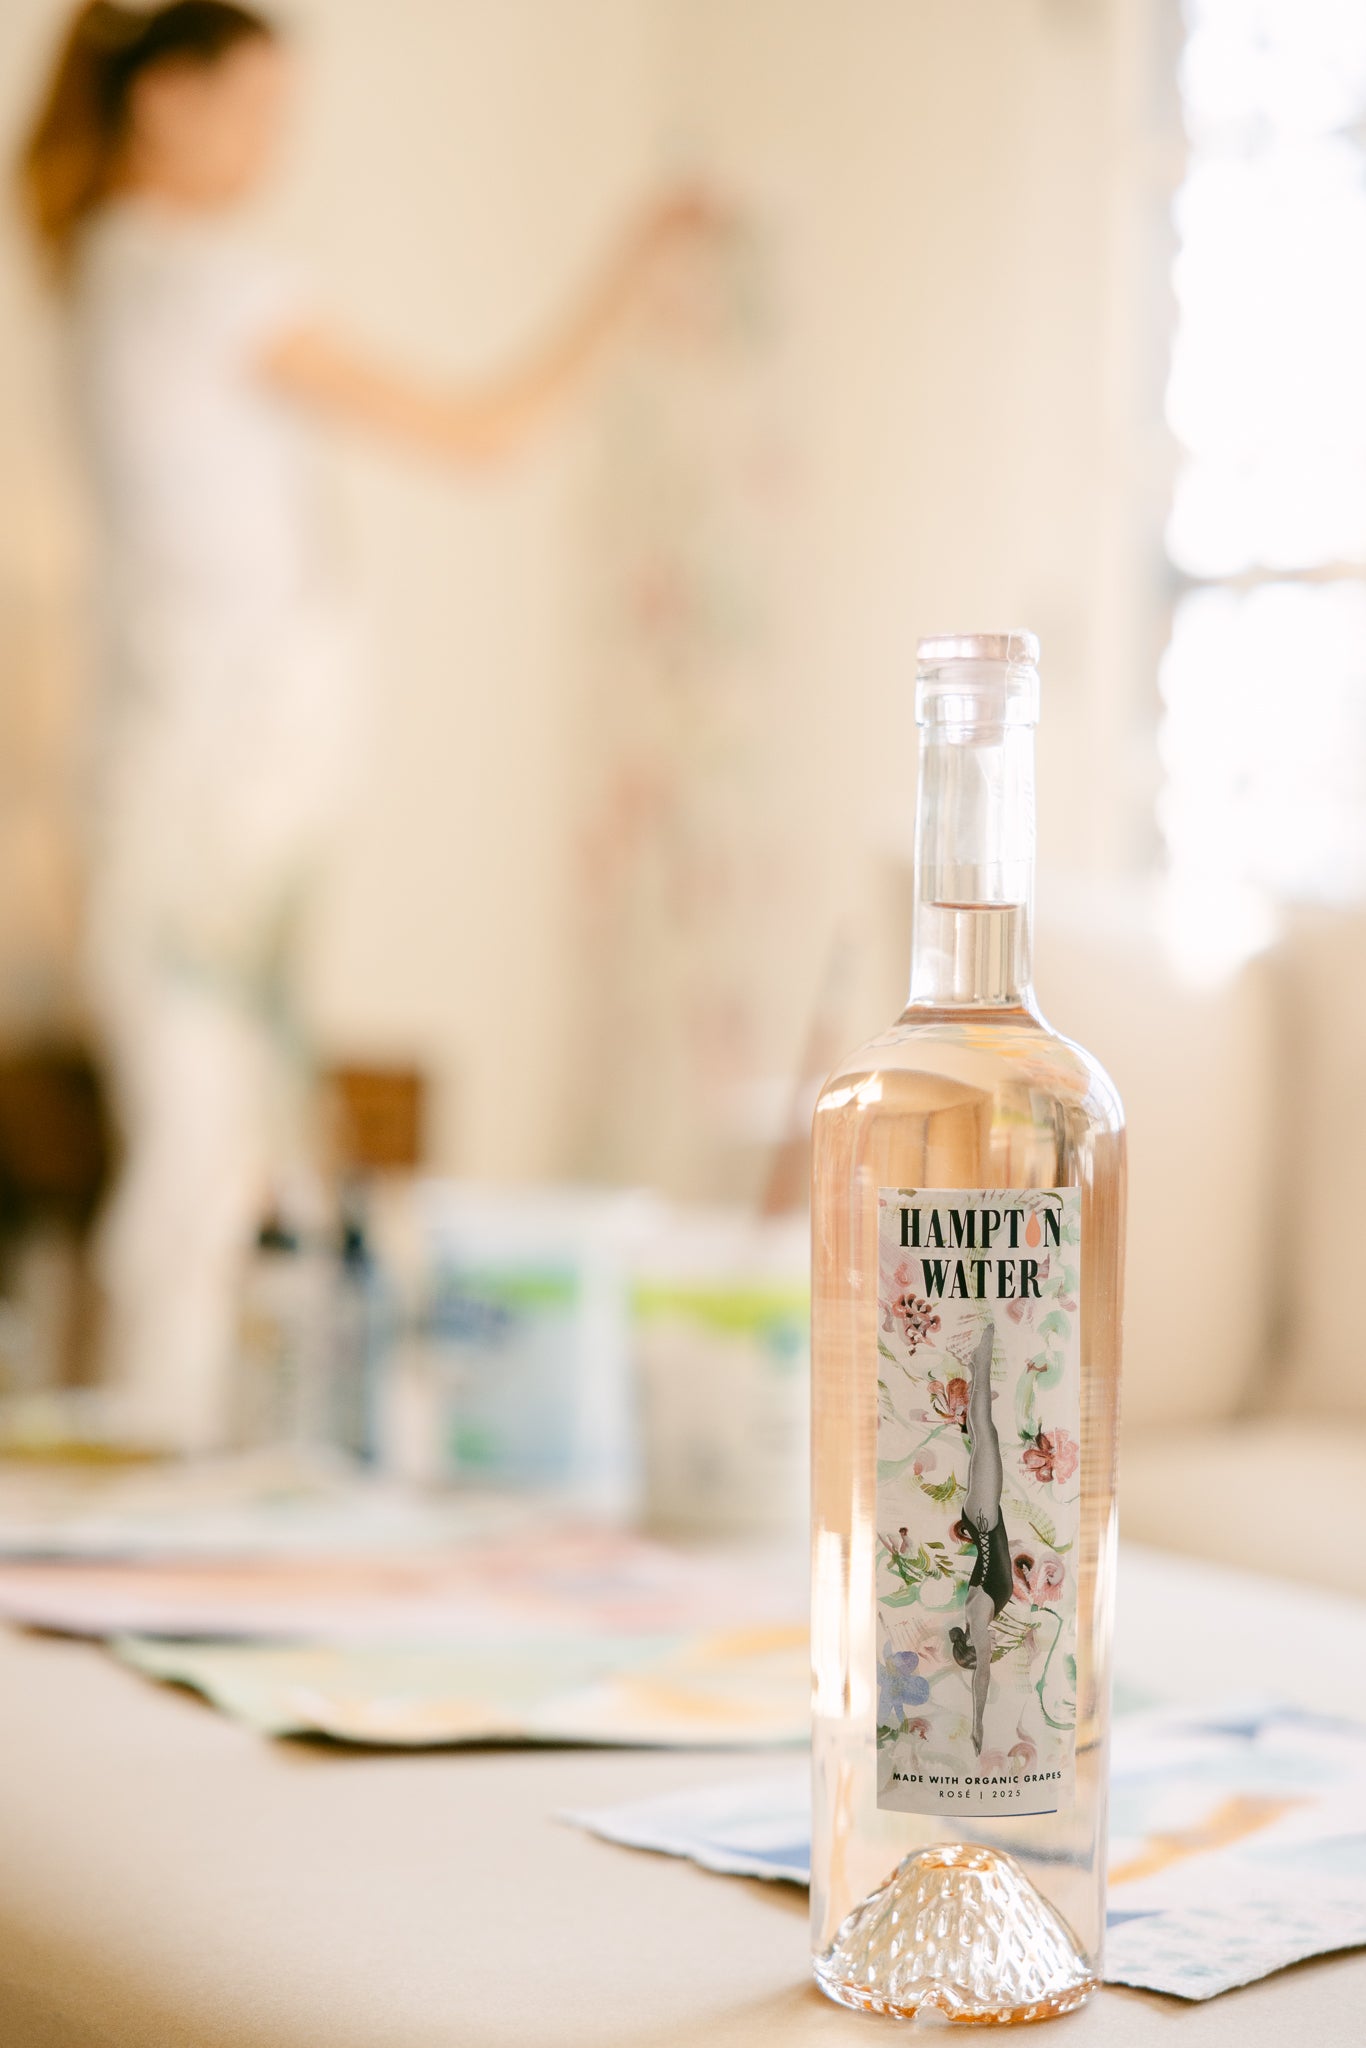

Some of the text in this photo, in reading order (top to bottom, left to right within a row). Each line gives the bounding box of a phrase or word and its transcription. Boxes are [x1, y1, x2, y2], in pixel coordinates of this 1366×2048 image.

[920, 1259, 1043, 1299] WATER
[892, 1771, 1062, 1785] MADE WITH ORGANIC GRAPES
[939, 1789, 971, 1798] ROSÉ
[992, 1789, 1022, 1798] 2025
